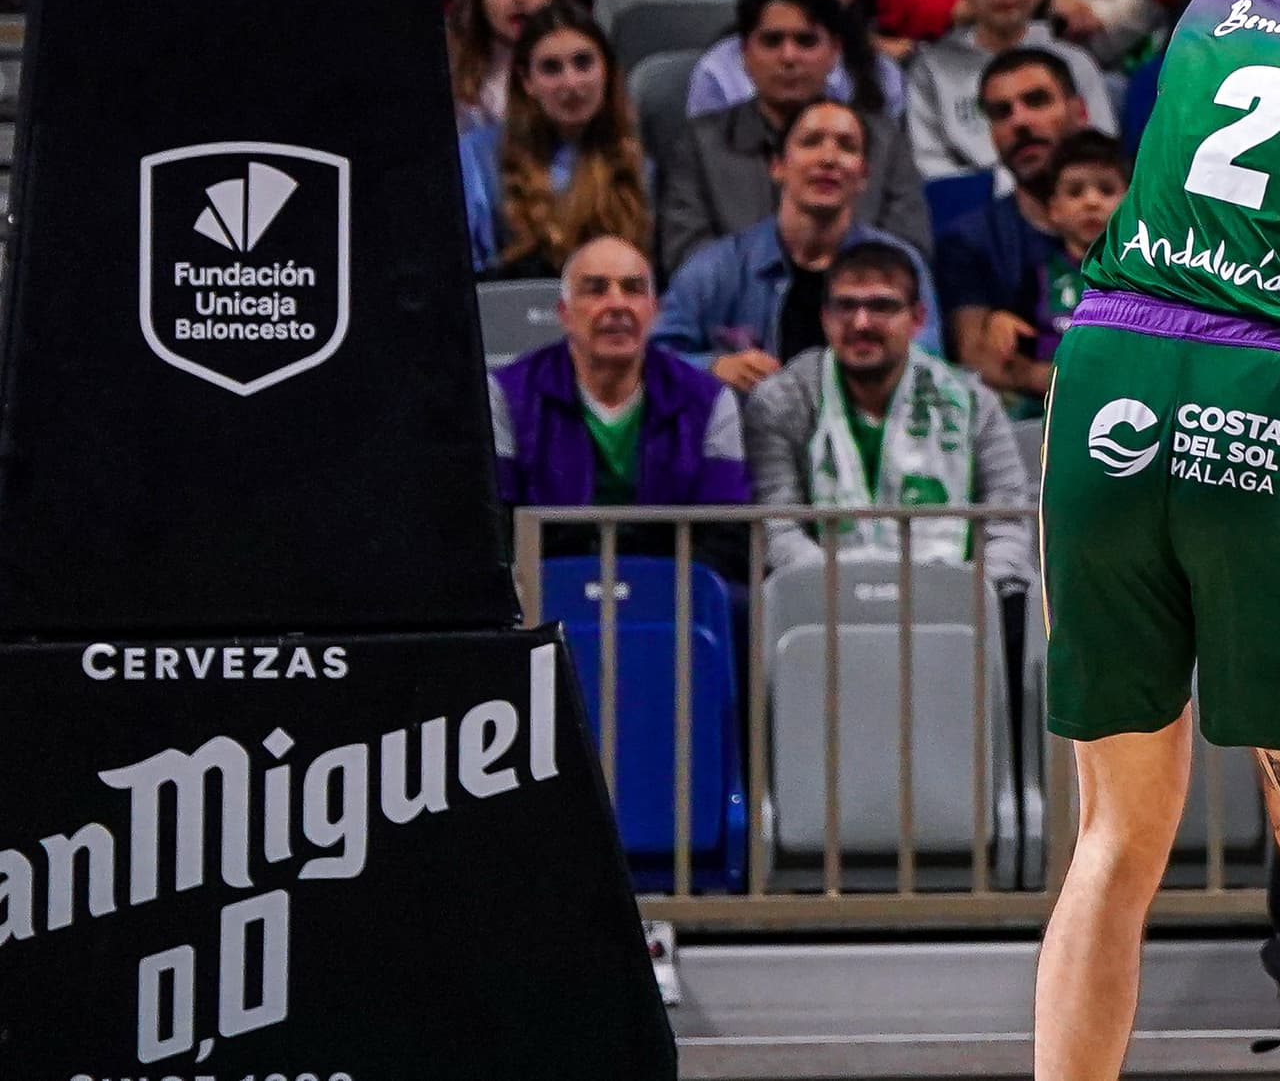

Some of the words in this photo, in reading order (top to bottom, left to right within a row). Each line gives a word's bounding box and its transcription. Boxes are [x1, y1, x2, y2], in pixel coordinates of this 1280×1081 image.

[174, 260, 316, 287] Fundación
[195, 291, 297, 322] Unicaja
[174, 318, 317, 340] Baloncesto
[1173, 431, 1222, 461] DEL
[1227, 441, 1280, 472] SOL
[81, 642, 350, 680] CERVEZAS
